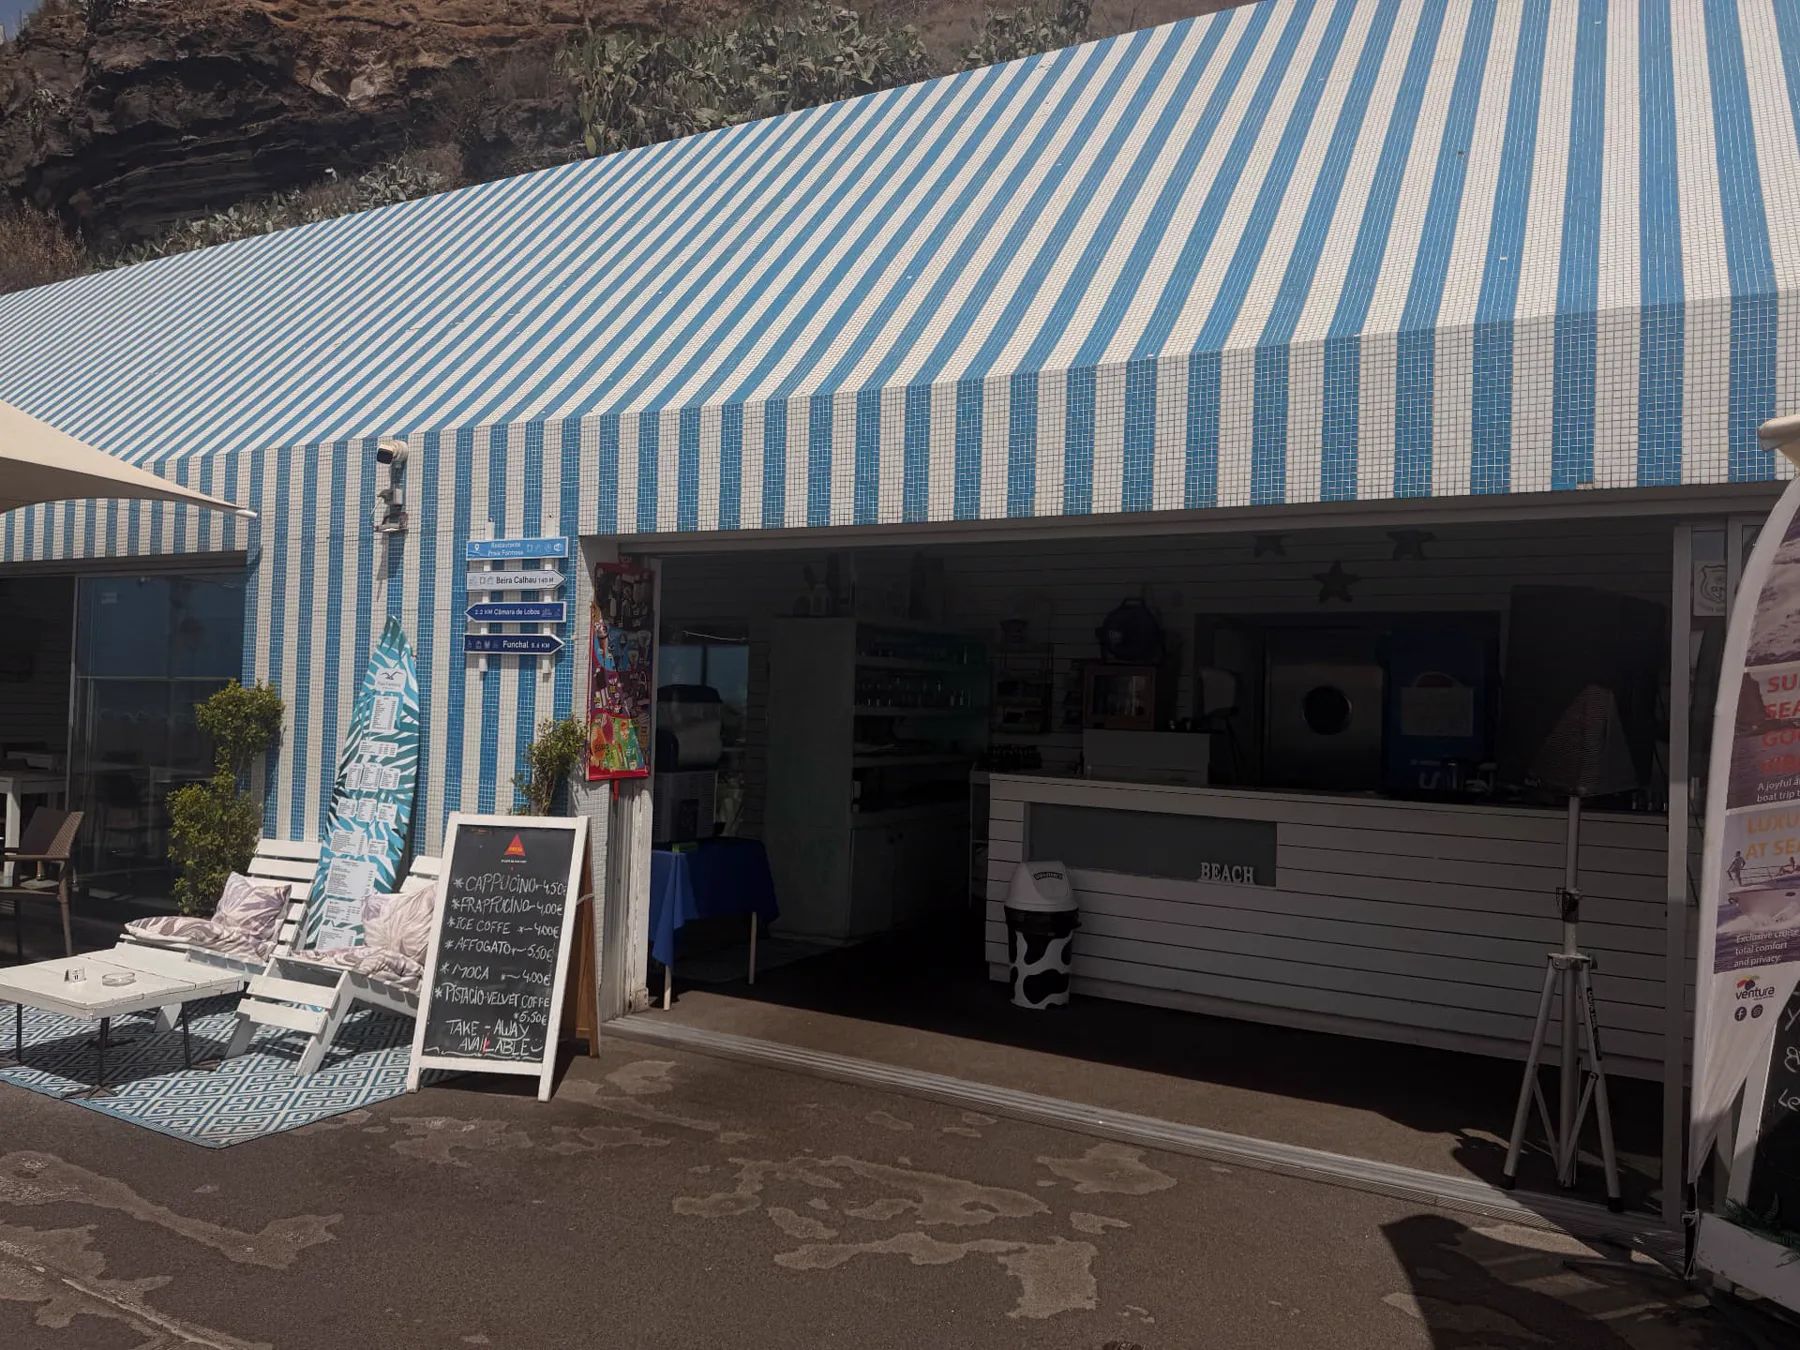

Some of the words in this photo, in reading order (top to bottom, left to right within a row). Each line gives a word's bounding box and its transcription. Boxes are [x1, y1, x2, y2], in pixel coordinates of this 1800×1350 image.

[496, 576, 513, 585] Beira
[513, 575, 537, 585] Calhau
[493, 608, 515, 616] Câmara
[502, 640, 529, 649] Funchal
[1767, 672, 1800, 693] SU
[1765, 778, 1792, 792] joyful
[1756, 792, 1777, 803] boat
[1779, 790, 1796, 801] trip
[1200, 862, 1254, 884] BEACH
[454, 916, 474, 931] ICE
[476, 920, 511, 936] COFFE
[454, 936, 512, 956] AFFOGATO
[1735, 944, 1754, 956] total
[1755, 941, 1788, 953] comfort
[1733, 959, 1749, 968] and
[452, 963, 490, 980] MOCA
[1735, 986, 1775, 1000] ventura
[521, 994, 550, 1009] COFFE
[445, 1018, 480, 1036] TAKE
[493, 1018, 530, 1041] AWAY
